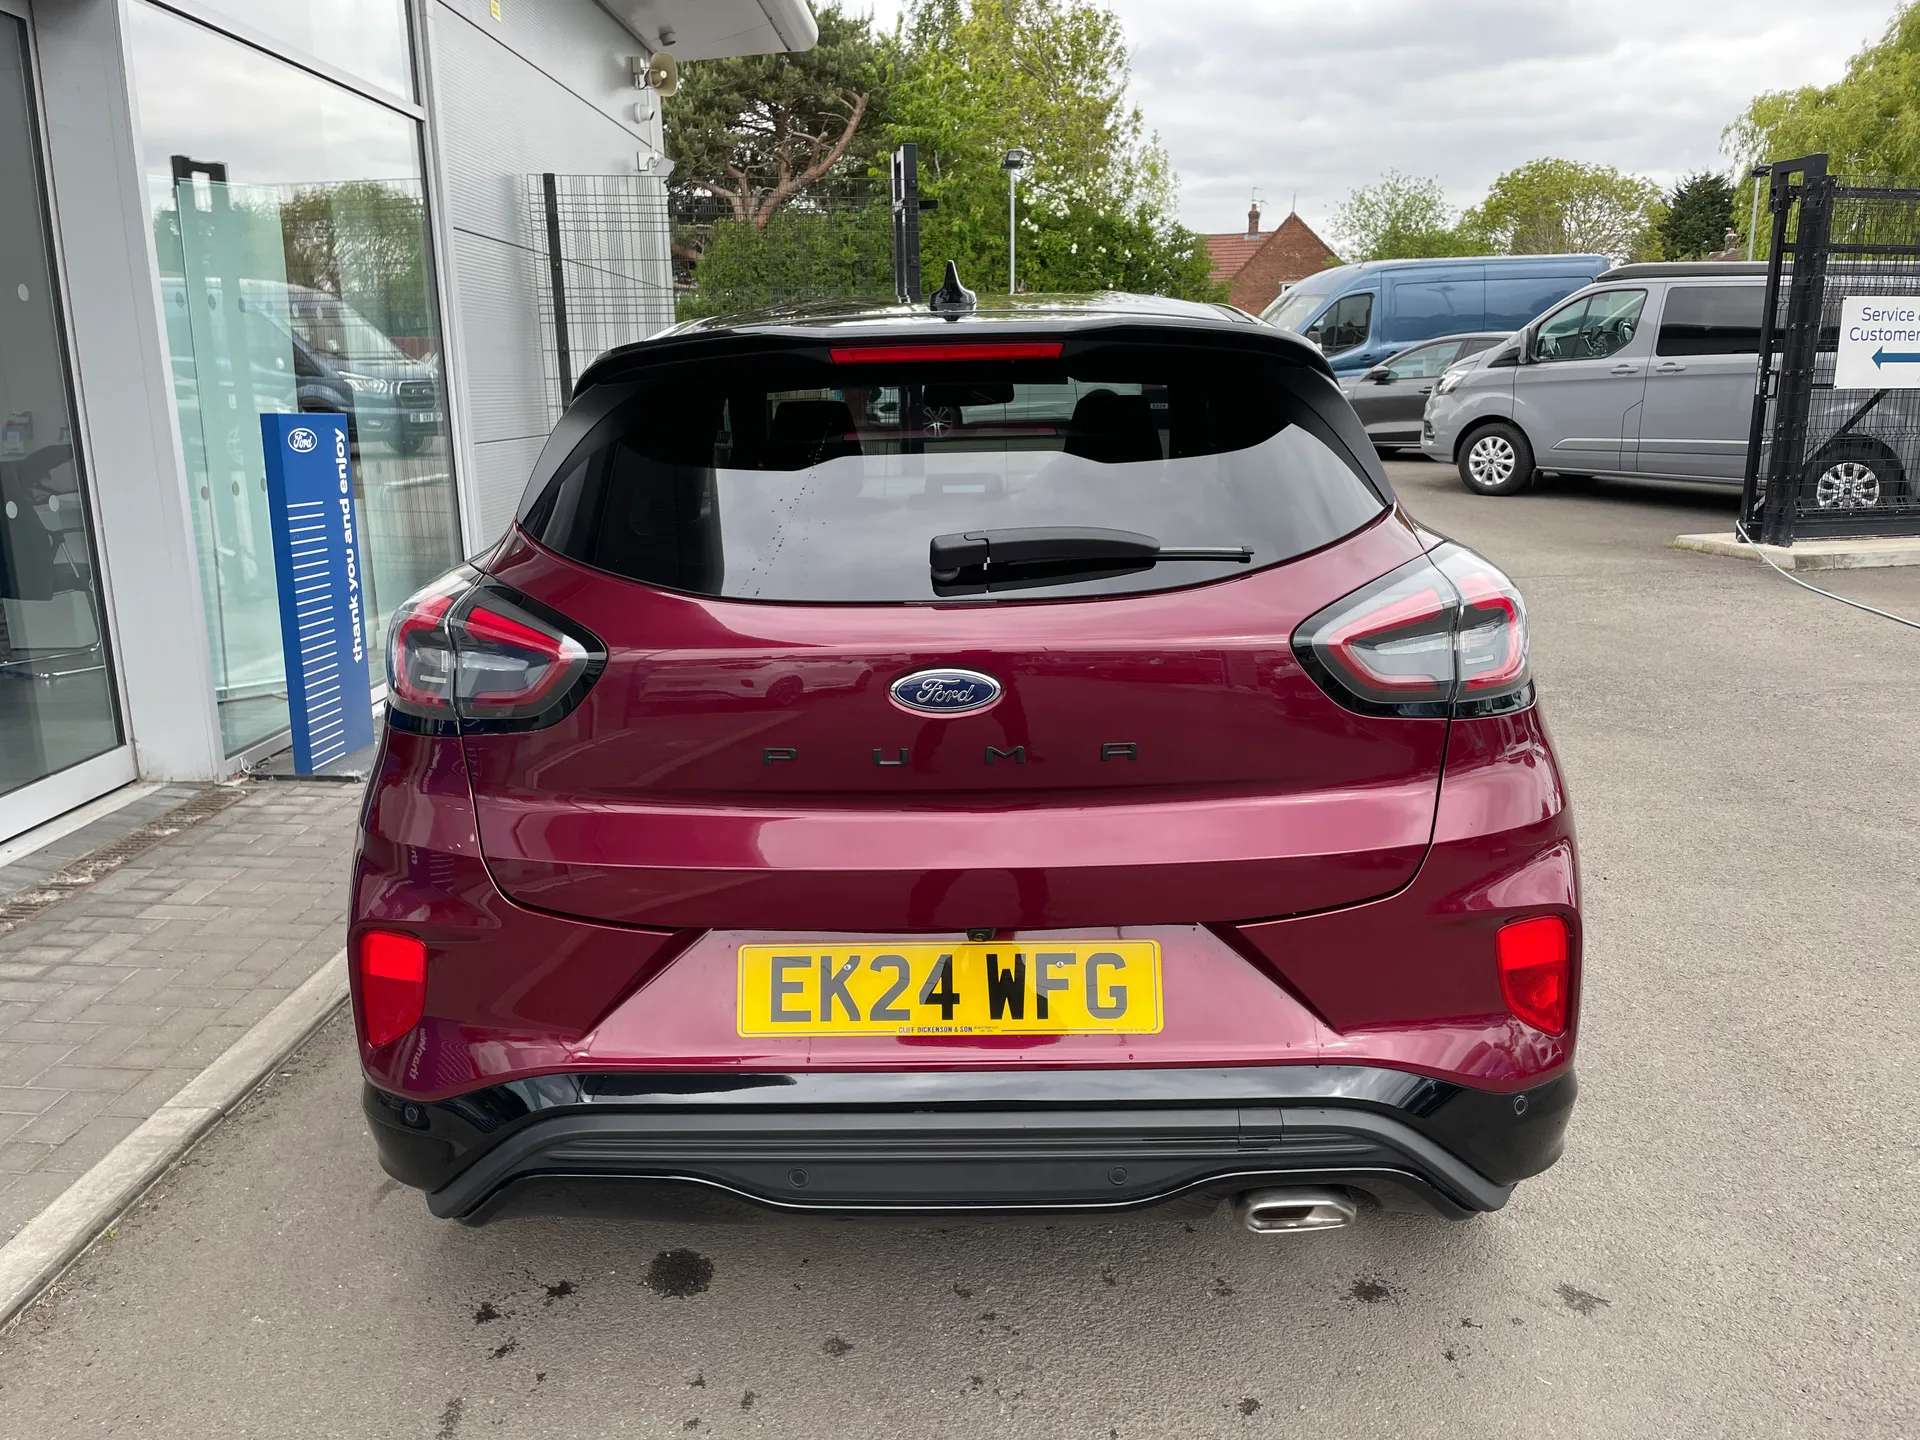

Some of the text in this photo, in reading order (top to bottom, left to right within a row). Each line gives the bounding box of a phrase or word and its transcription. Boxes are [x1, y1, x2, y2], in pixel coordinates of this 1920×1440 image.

[1861, 306, 1915, 322] Service
[1849, 326, 1920, 342] Customer
[293, 431, 313, 449] Ford
[335, 427, 363, 664] thank you and enjoy
[916, 678, 975, 703] Ford
[762, 741, 1138, 767] PUMA
[769, 951, 1128, 1023] EK24 WFG
[917, 1025, 953, 1033] DICKENSON
[960, 1025, 973, 1033] SON
